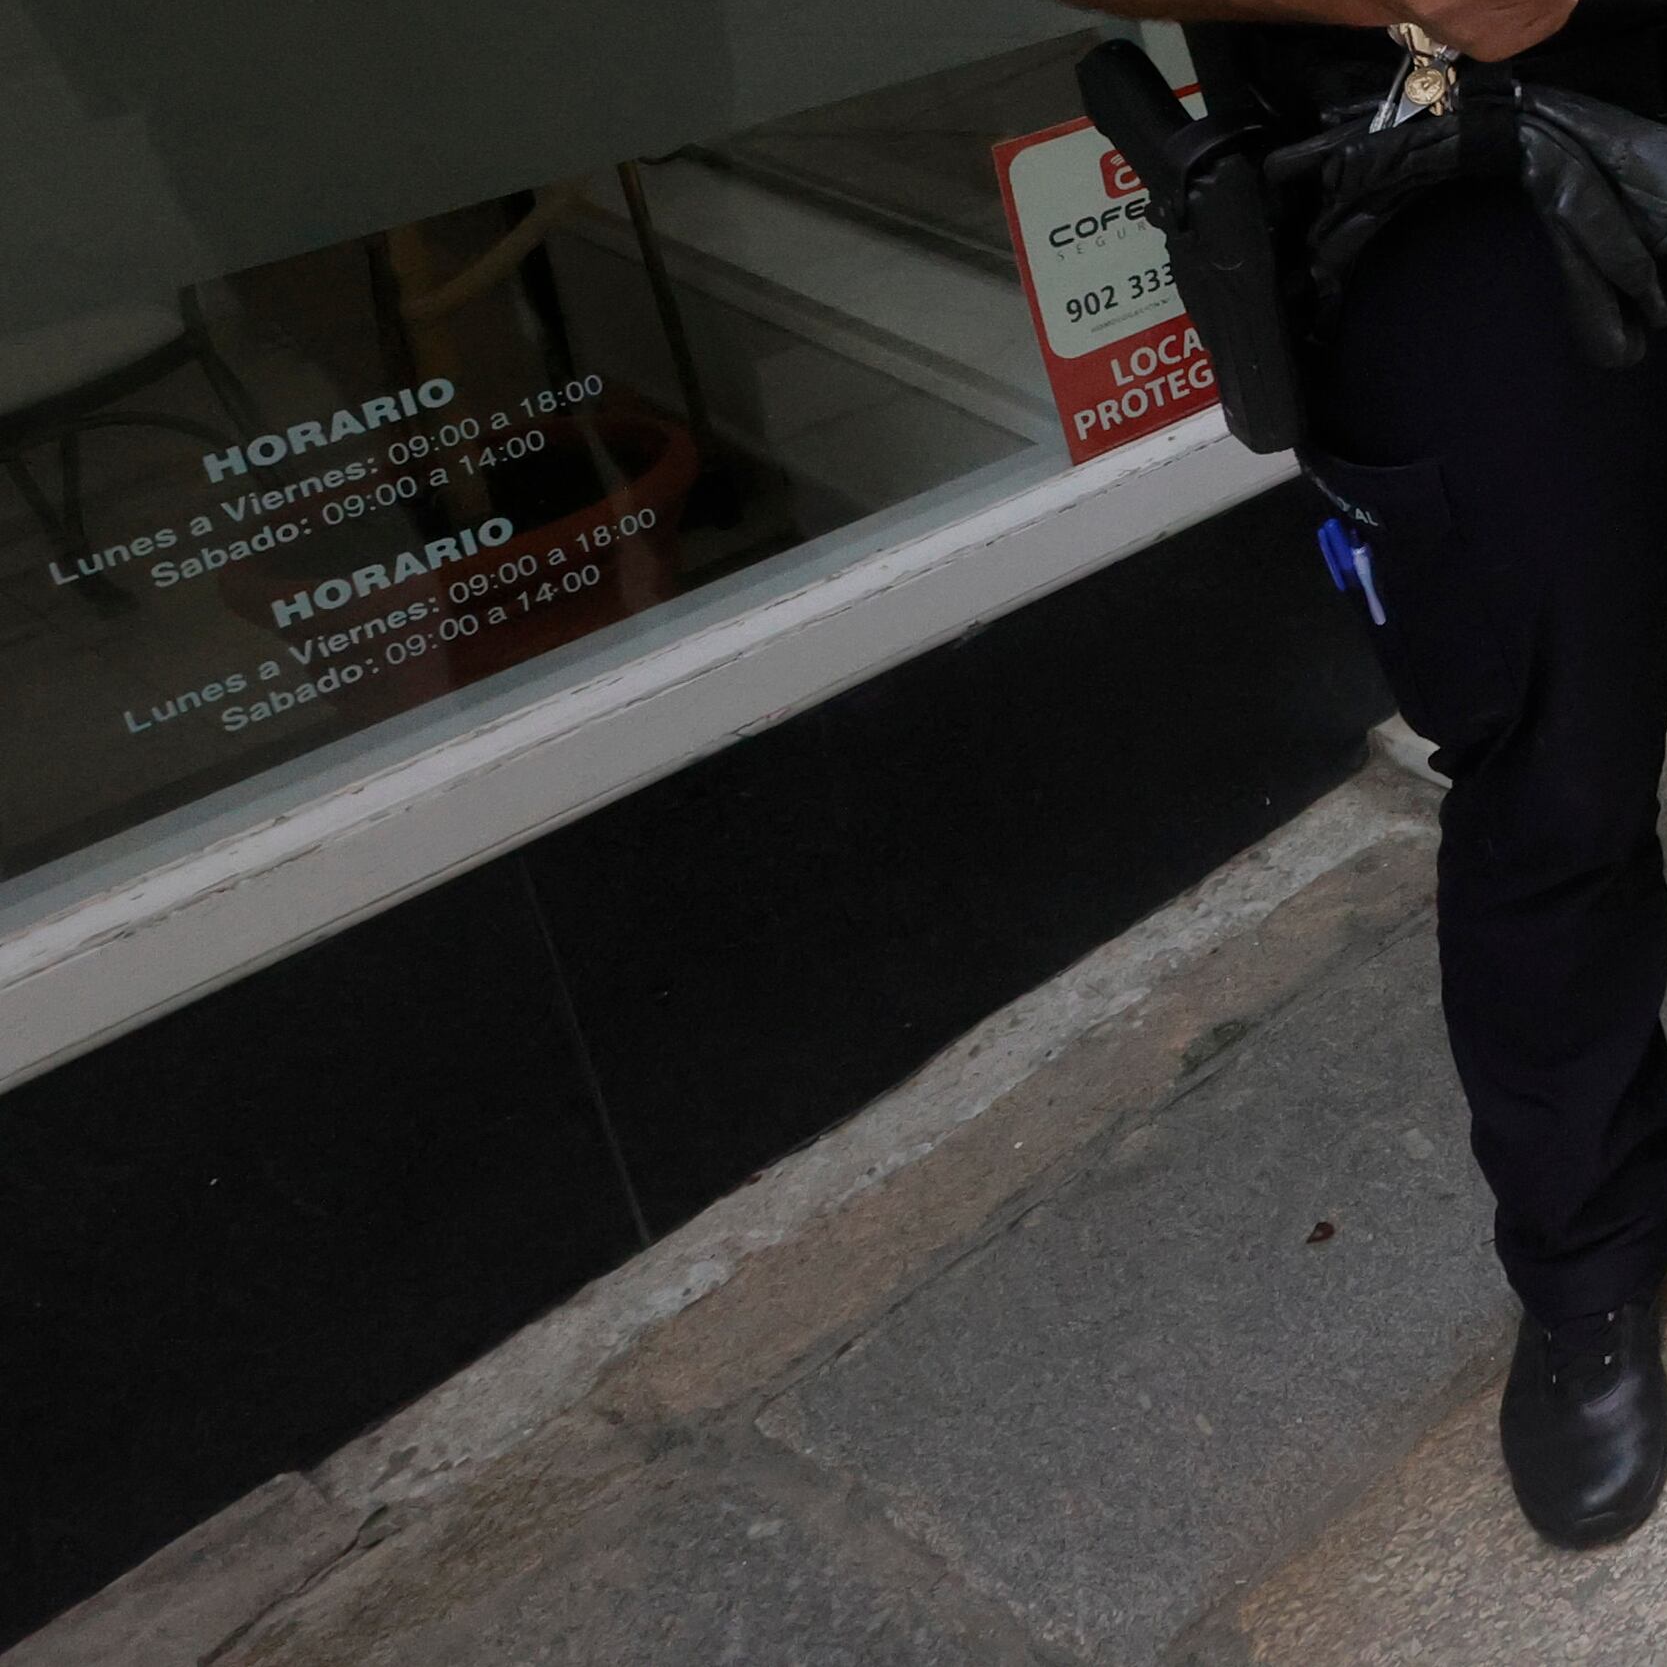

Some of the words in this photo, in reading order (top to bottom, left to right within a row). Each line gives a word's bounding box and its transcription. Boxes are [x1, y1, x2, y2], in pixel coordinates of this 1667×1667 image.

[1048, 198, 1147, 249] COFE
[1056, 221, 1147, 263] SEGUR
[1065, 284, 1119, 323] 902
[1073, 359, 1215, 441] PROTEG
[1110, 327, 1205, 387] LOCA
[48, 522, 178, 586] Lunes
[189, 513, 213, 536] a
[221, 457, 379, 524] Viernes:
[387, 416, 481, 466] 09:00
[490, 408, 512, 430] a
[519, 374, 604, 416] 18:00
[202, 377, 456, 483] HORARIO
[151, 515, 311, 590] Sabado:
[321, 475, 418, 526] 09:00
[429, 465, 450, 486] a
[459, 430, 546, 476] 14:00
[122, 670, 249, 735] Lunes
[258, 658, 281, 680] a
[288, 595, 441, 666] Viernes:
[448, 553, 539, 606] 09:00
[547, 544, 568, 566] a
[574, 506, 658, 555] 18:00
[270, 516, 514, 628] HORARIO
[221, 660, 381, 733] Sabado:
[385, 613, 479, 666] 09:00
[487, 604, 508, 626] a
